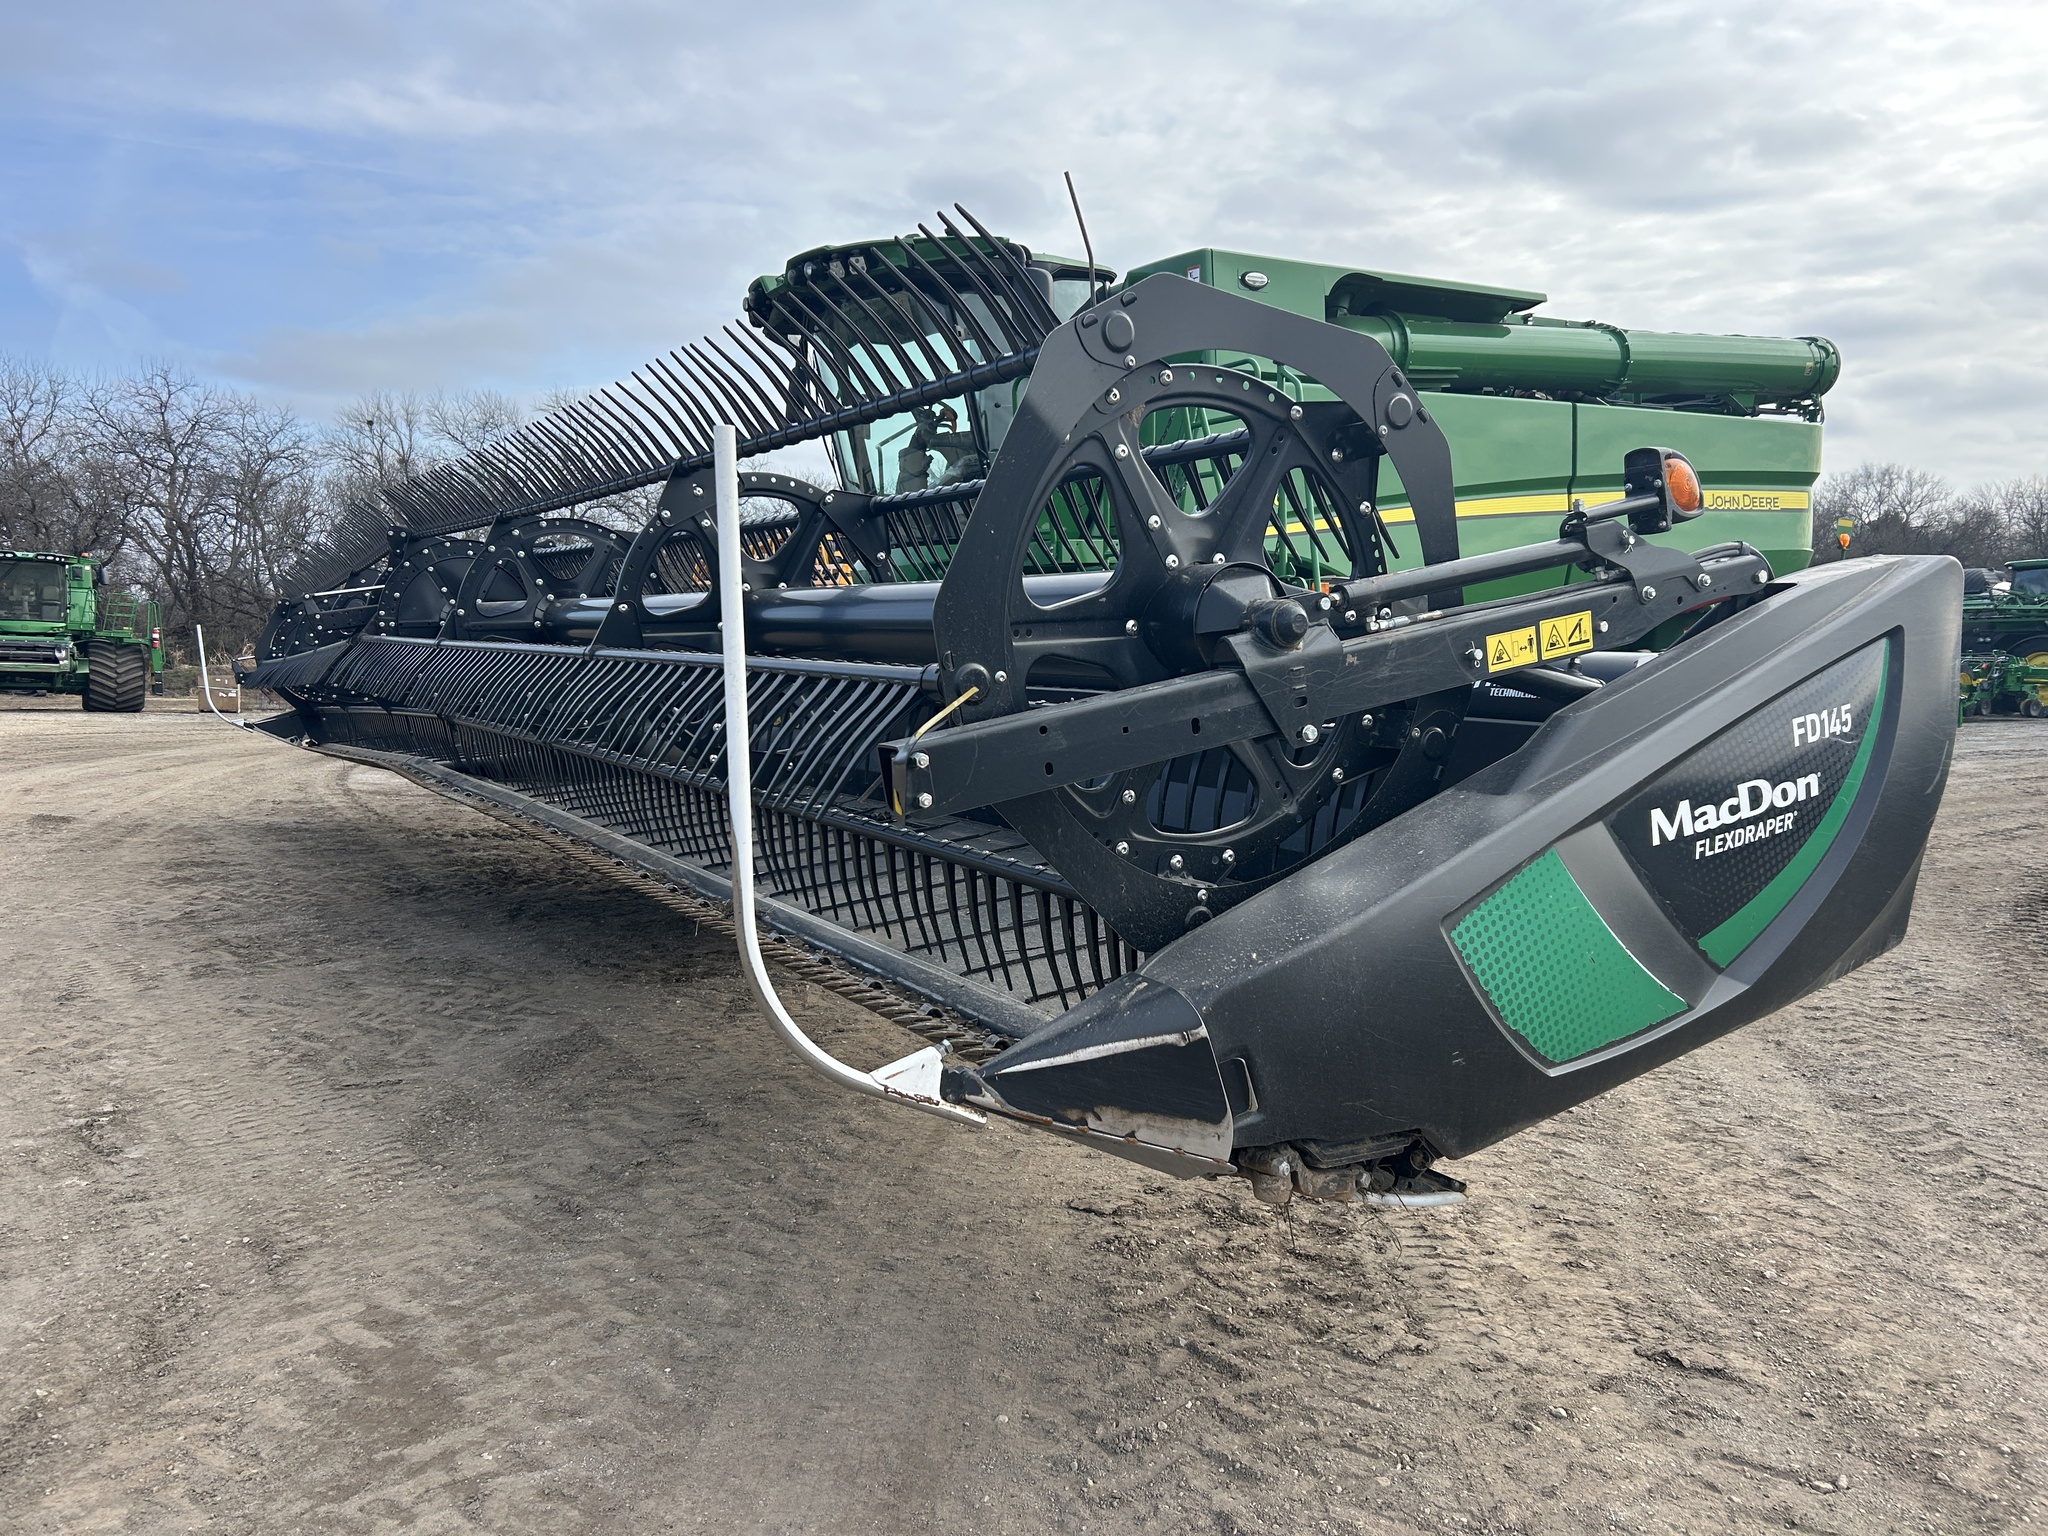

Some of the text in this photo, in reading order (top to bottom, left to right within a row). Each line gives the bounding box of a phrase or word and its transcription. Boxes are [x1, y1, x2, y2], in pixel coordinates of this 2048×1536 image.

[1708, 493, 1780, 508] JOHN DEERE
[1792, 703, 1852, 747] FD145
[1650, 772, 1819, 847] MacDon
[1695, 812, 1794, 860] FLEXDRAPER
